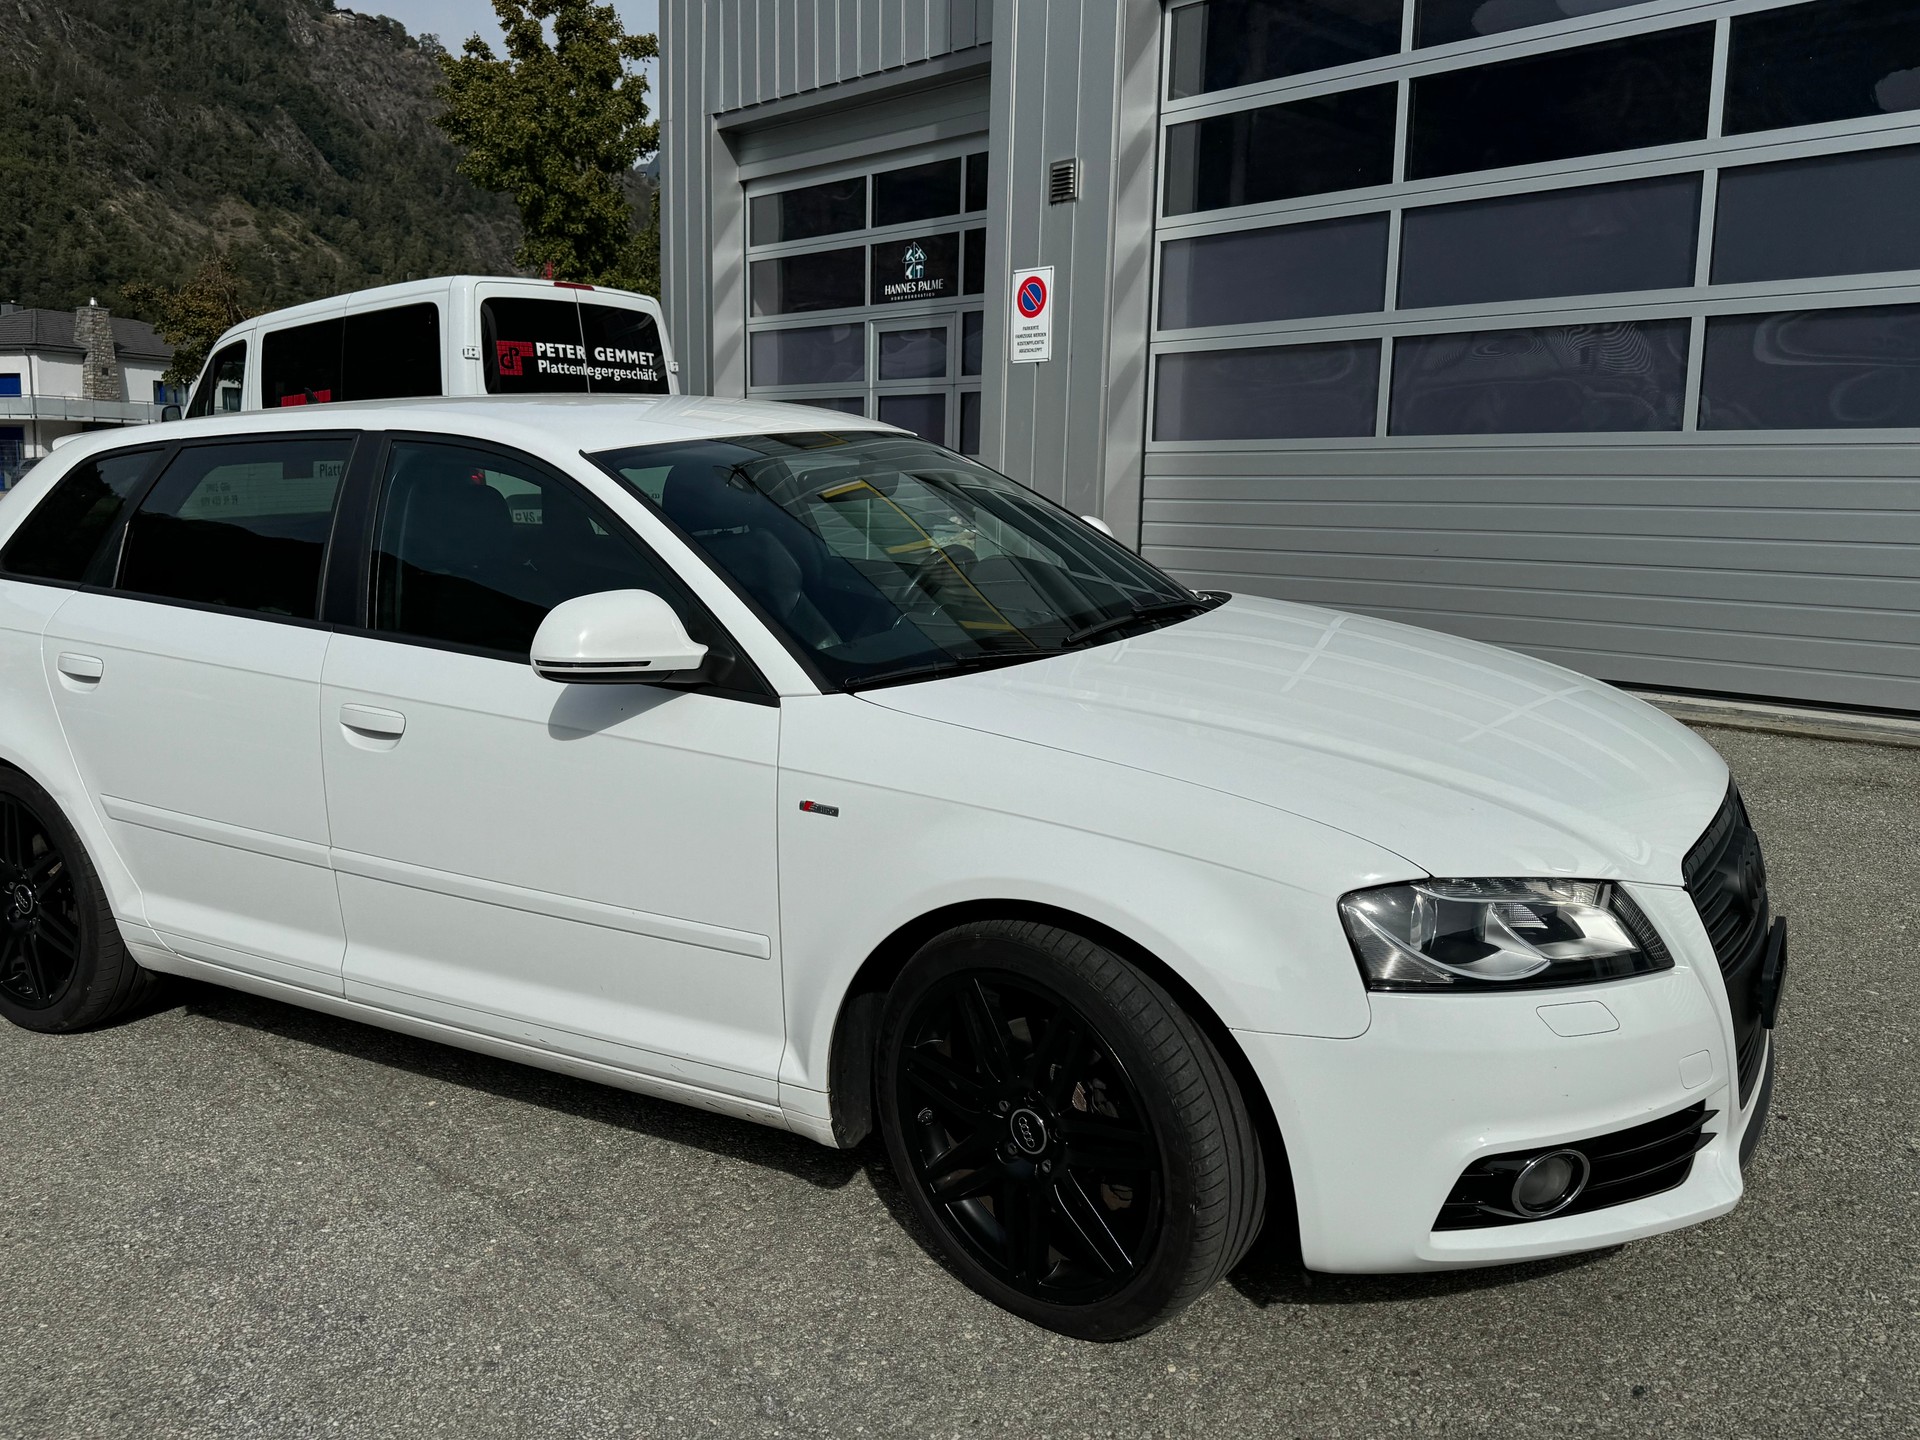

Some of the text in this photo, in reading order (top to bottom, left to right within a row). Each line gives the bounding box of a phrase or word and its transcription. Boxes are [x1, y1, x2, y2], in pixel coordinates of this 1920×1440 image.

[884, 278, 944, 295] HANNES PALME
[535, 342, 655, 366] PETER GEMMET
[537, 359, 658, 382] Plattenlegergeschäft
